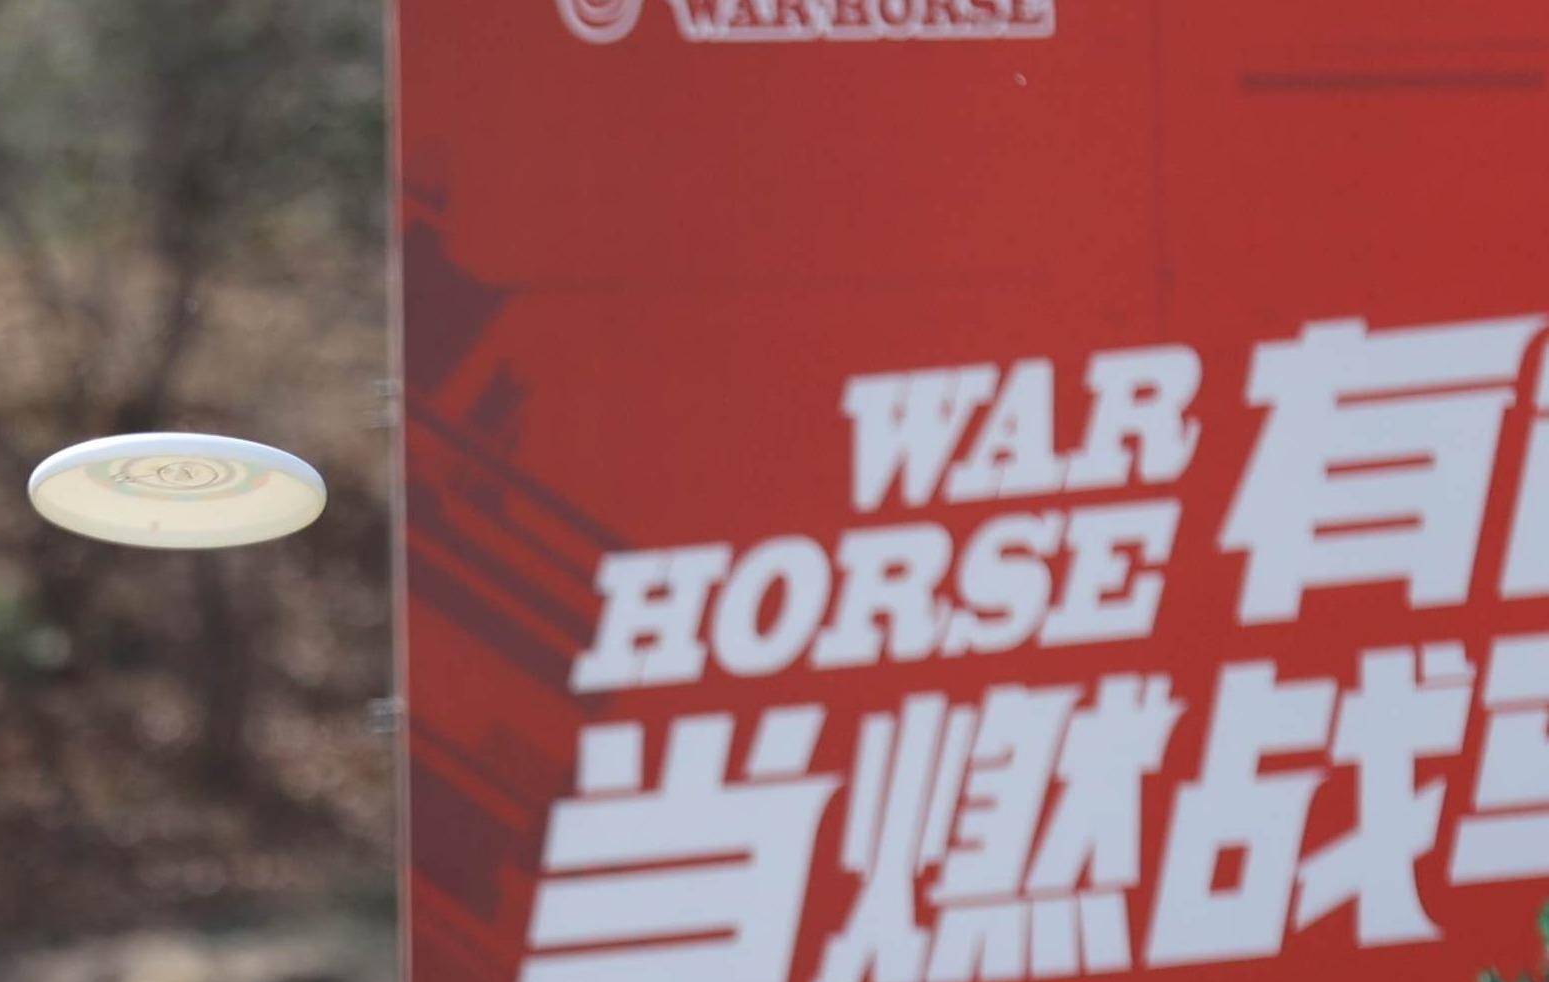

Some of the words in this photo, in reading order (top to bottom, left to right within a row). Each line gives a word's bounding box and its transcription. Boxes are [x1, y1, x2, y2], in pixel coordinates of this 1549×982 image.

[842, 346, 1201, 511] WAR
[1218, 314, 1549, 625] 有
[572, 500, 1182, 692] HORSE
